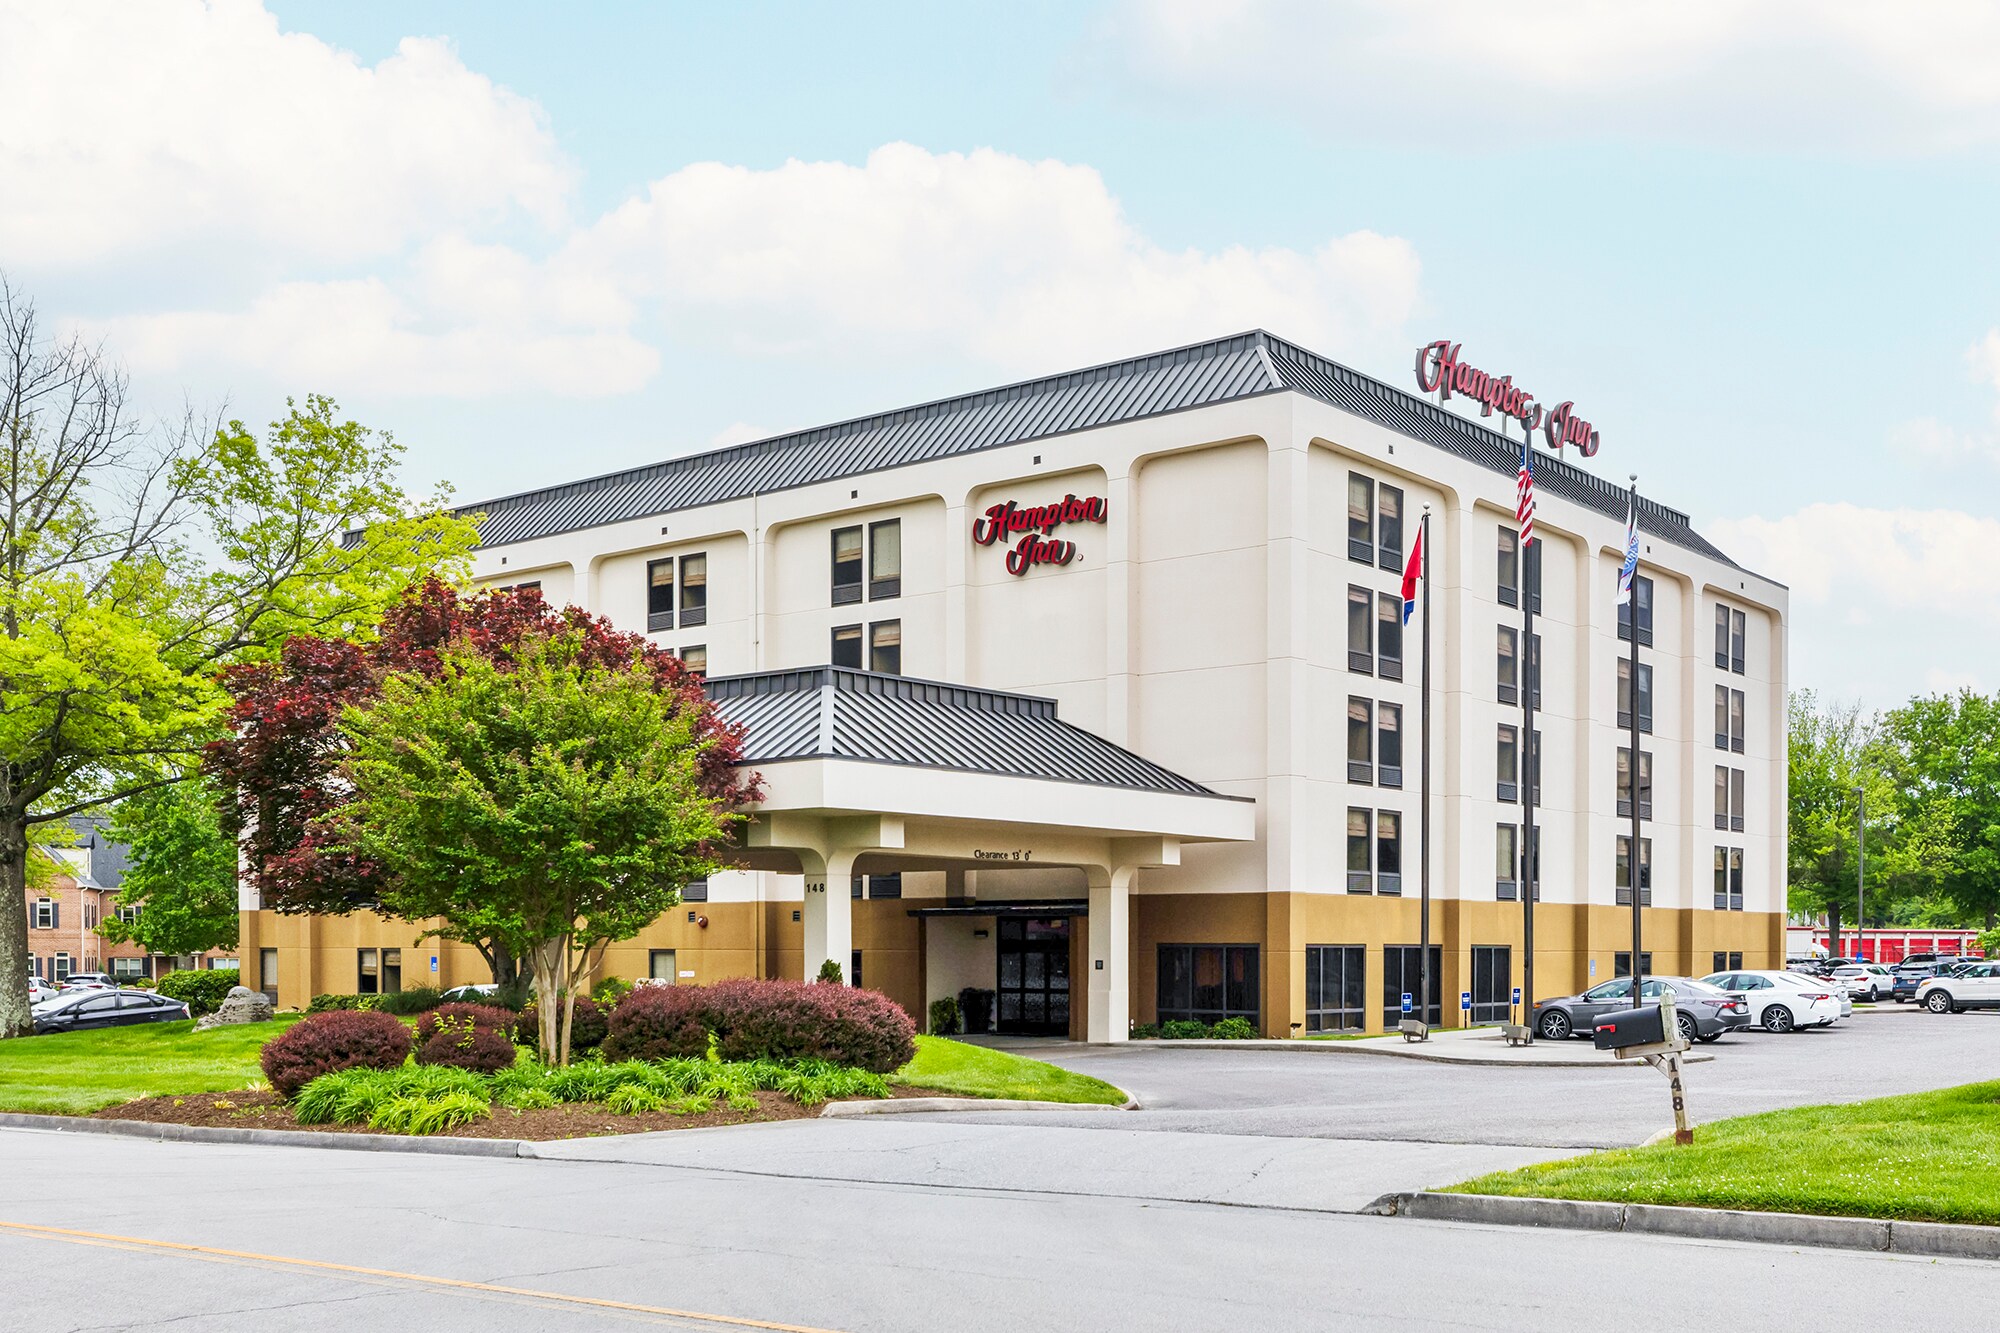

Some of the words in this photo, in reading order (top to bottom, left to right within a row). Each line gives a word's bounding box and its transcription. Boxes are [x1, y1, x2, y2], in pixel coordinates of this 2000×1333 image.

[1545, 401, 1599, 457] Inn
[973, 494, 1107, 546] Hampton
[1006, 533, 1076, 577] Inn
[974, 849, 1008, 859] Clearance
[806, 883, 825, 893] 148
